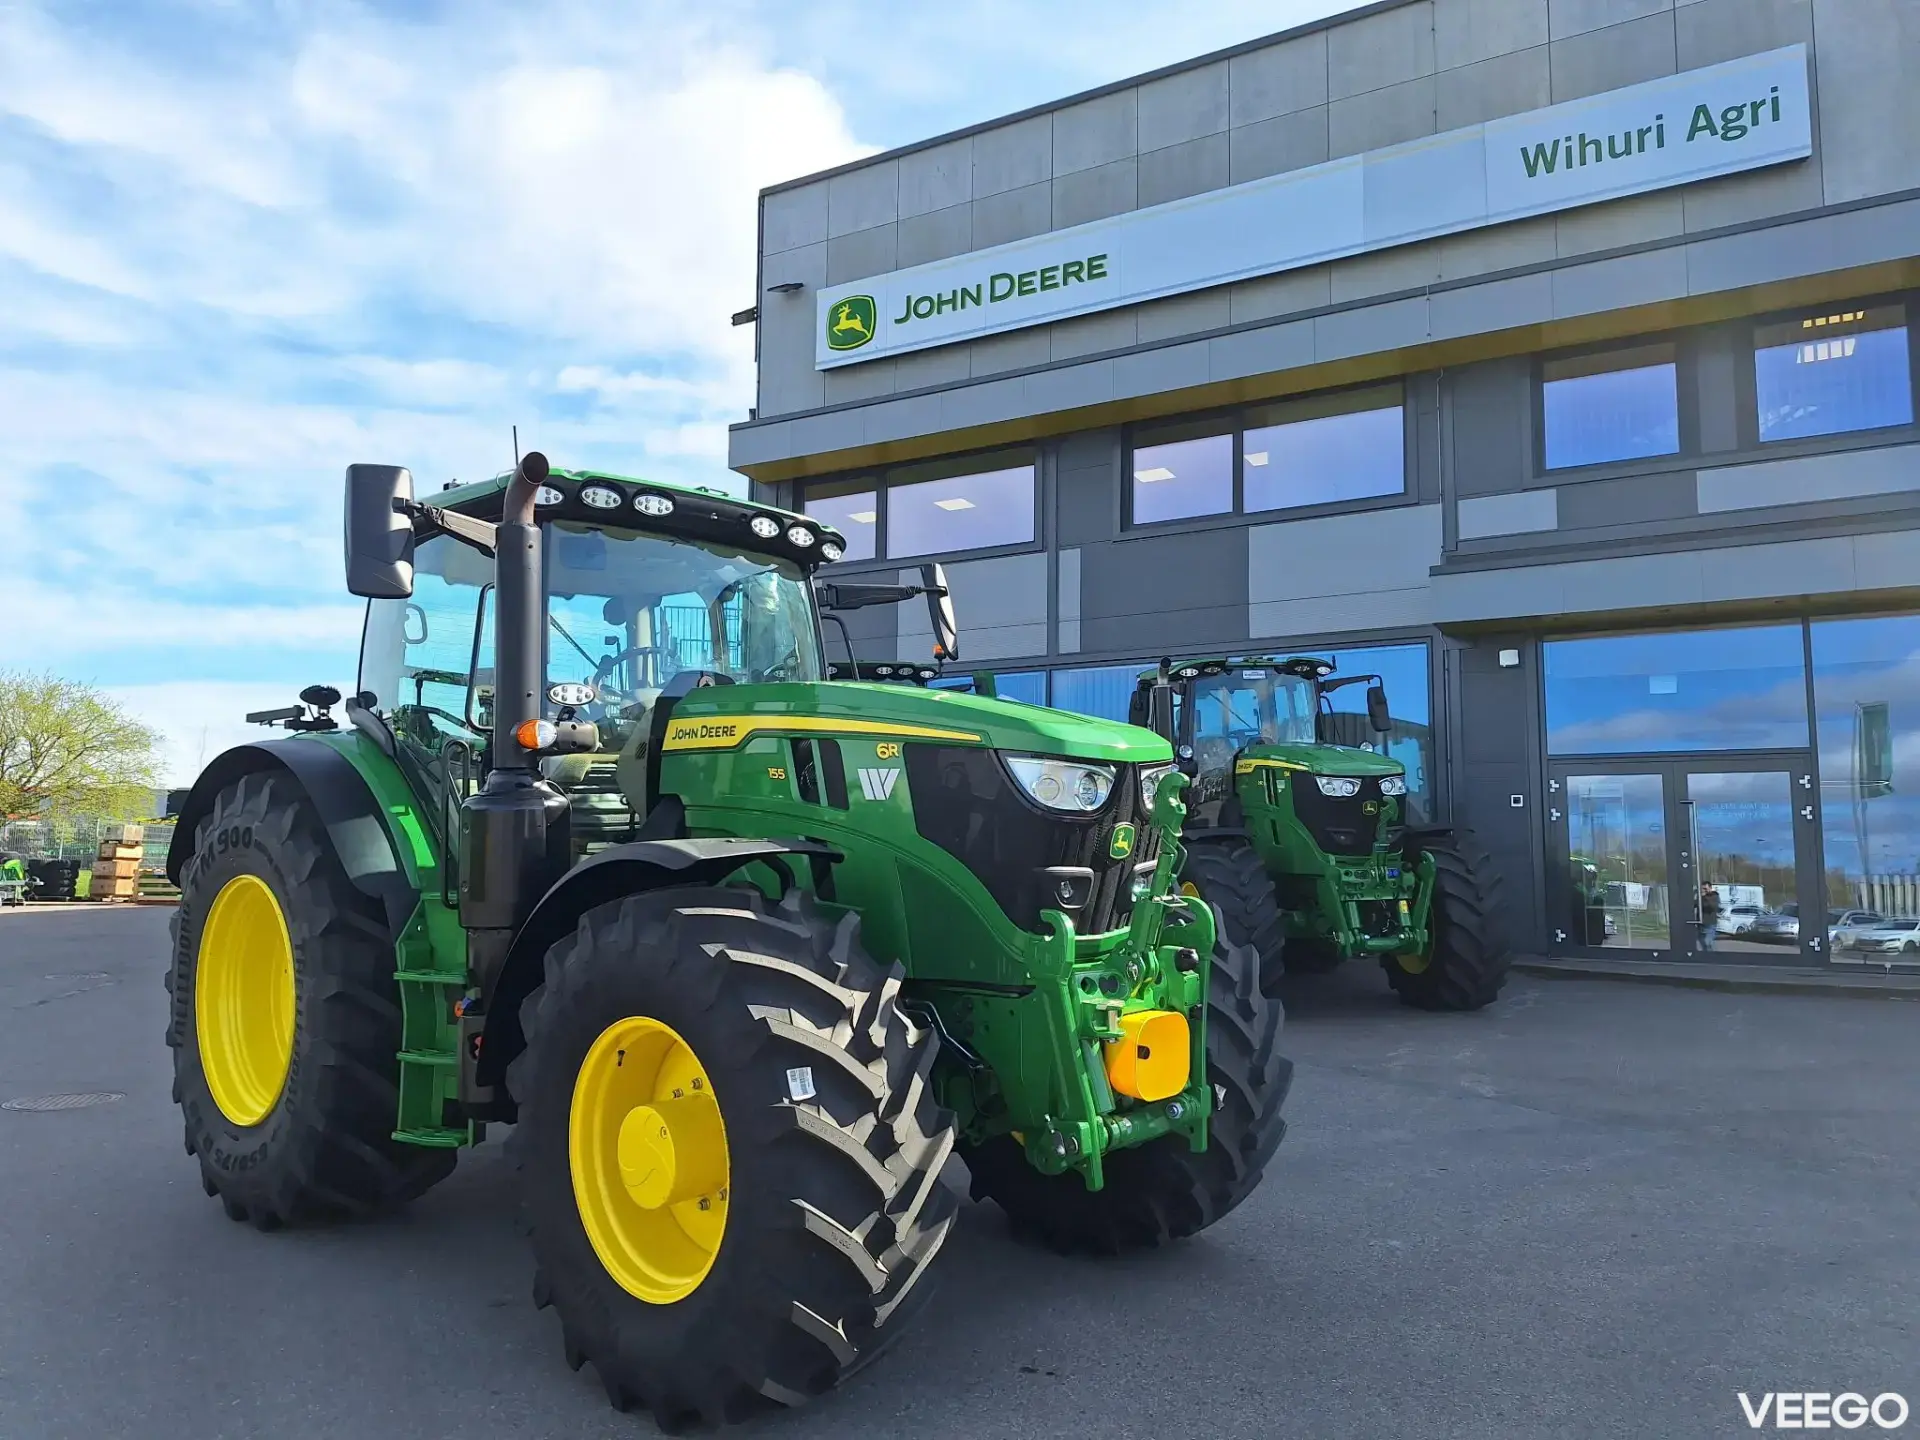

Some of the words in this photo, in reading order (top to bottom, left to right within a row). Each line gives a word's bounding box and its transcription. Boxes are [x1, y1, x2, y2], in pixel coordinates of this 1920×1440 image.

[1520, 114, 1665, 178] Wihuri
[1686, 86, 1780, 142] Agri
[894, 284, 983, 325] JOHN
[989, 254, 1108, 304] DEERE
[672, 725, 698, 740] JOHN
[700, 725, 737, 739] DEERE
[876, 742, 900, 760] 6R
[767, 767, 786, 780] 155
